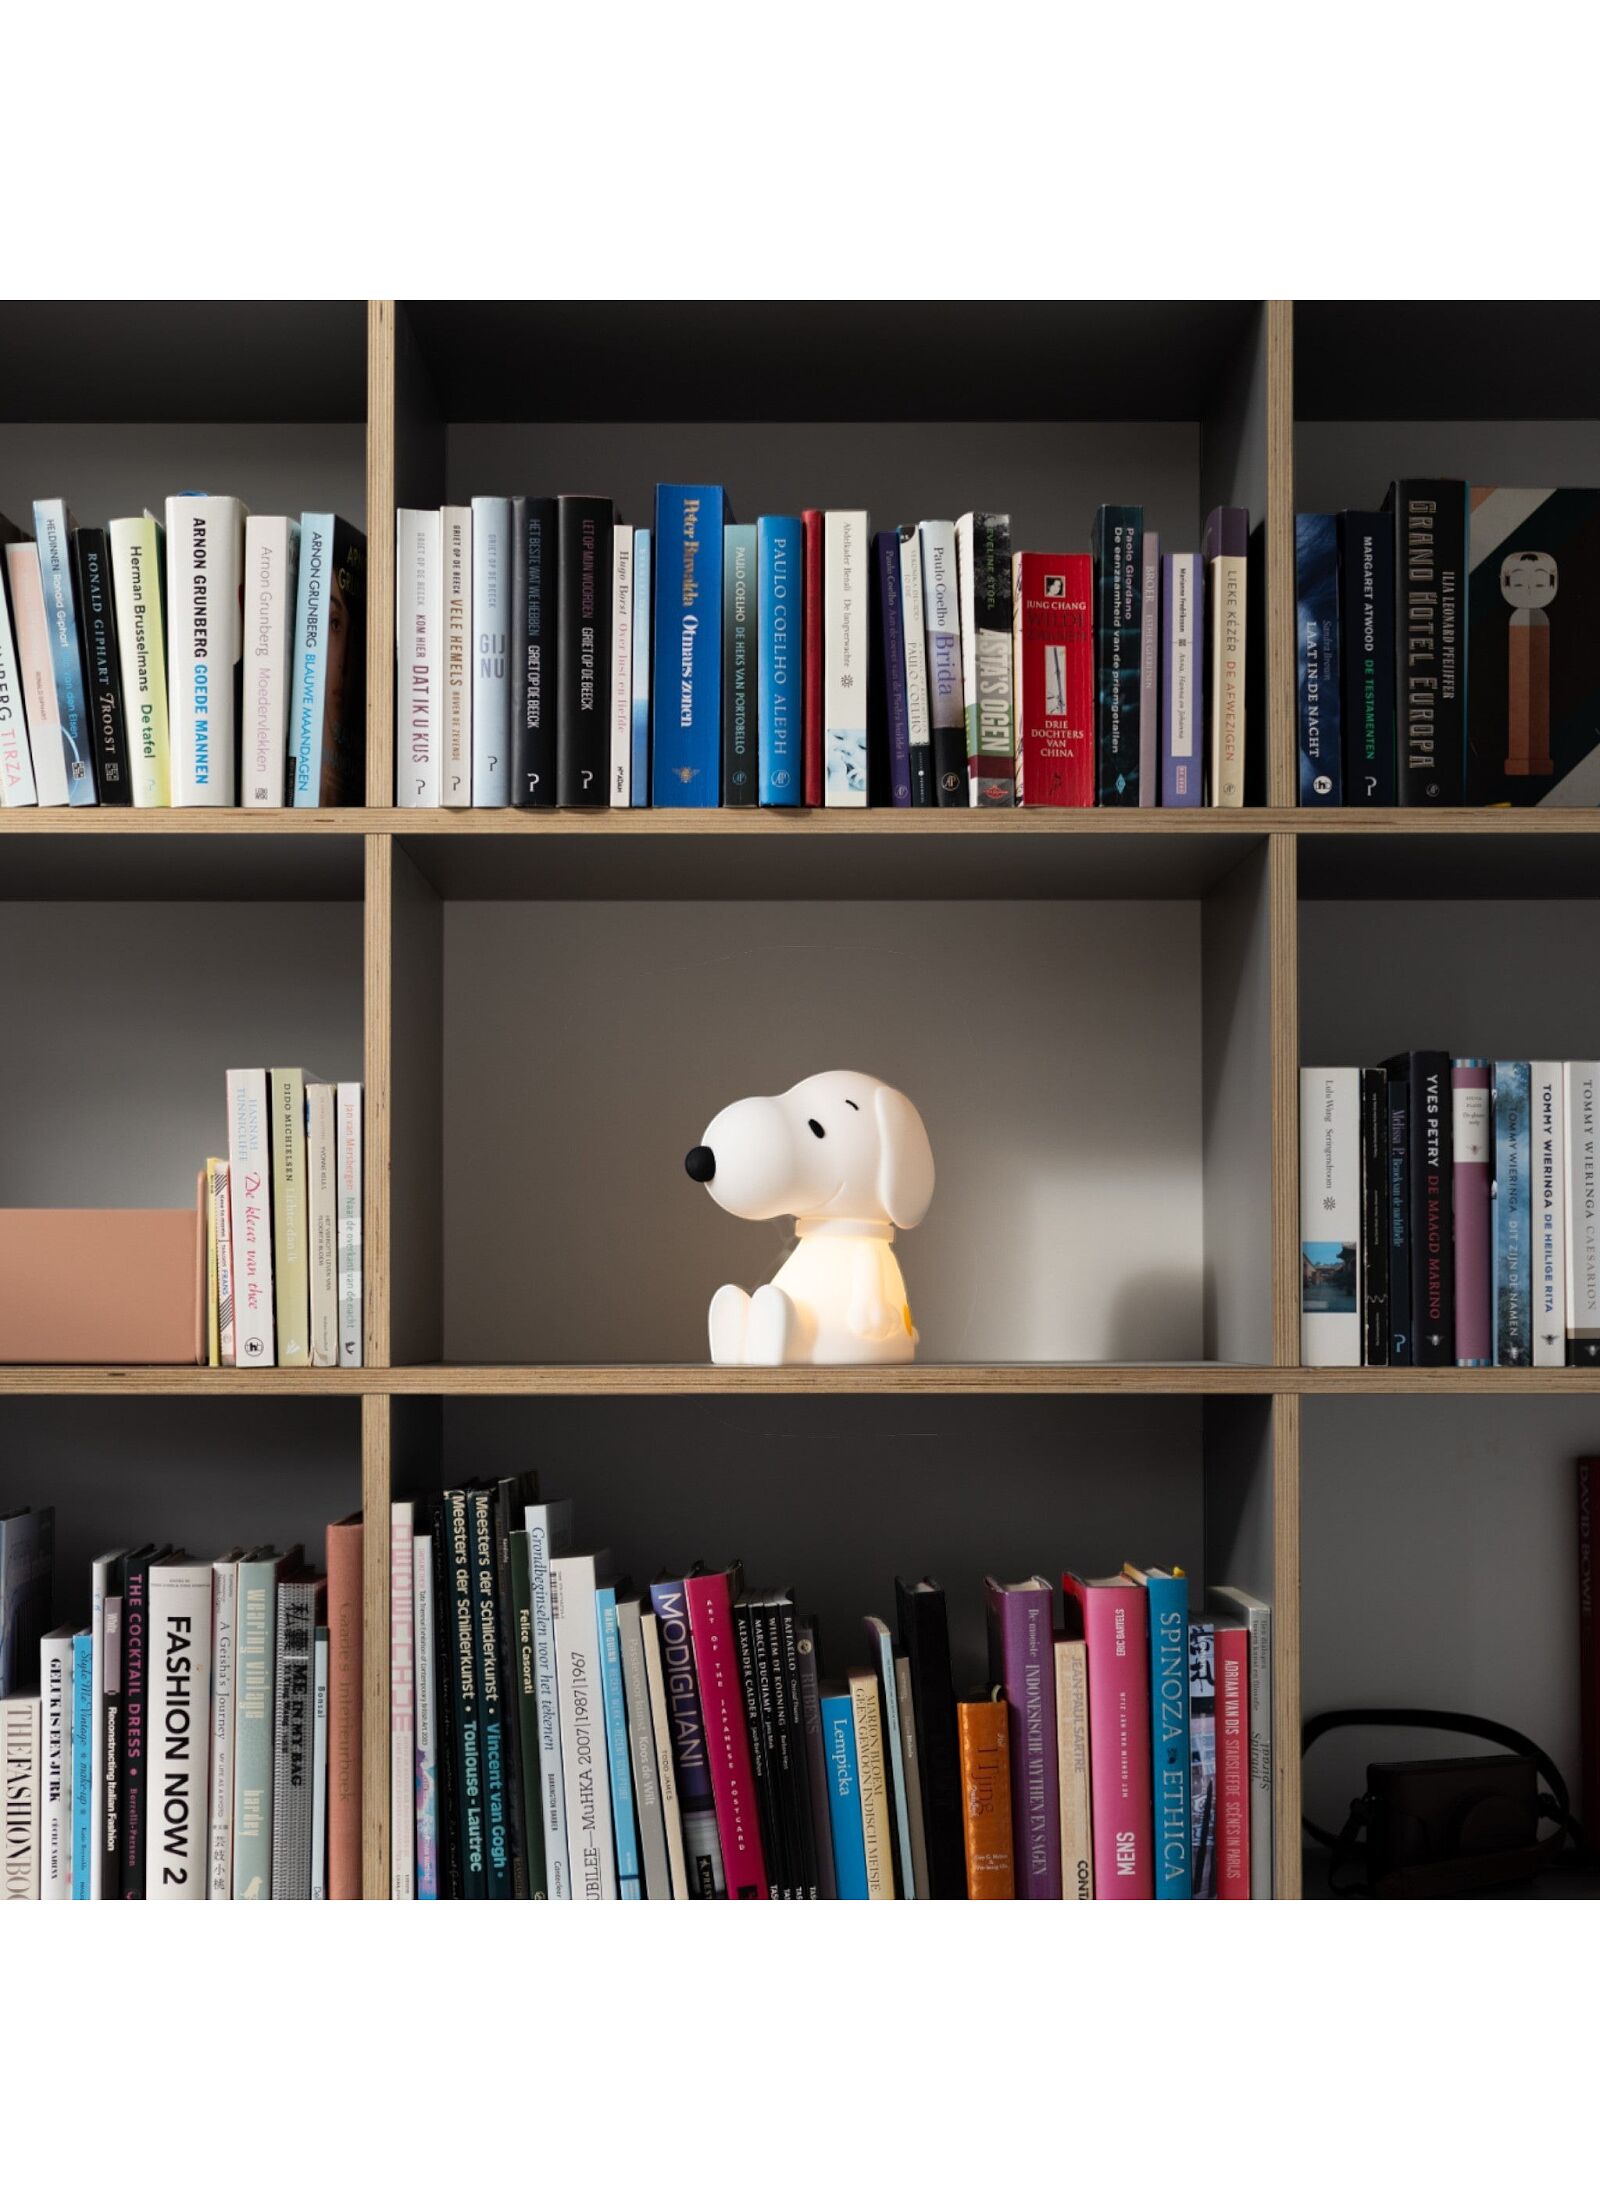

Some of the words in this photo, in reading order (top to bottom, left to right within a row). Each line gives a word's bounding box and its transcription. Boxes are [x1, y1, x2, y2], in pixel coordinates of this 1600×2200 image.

[683, 499, 700, 538] Peter
[1114, 527, 1122, 542] De
[1407, 500, 1437, 581] GRAND
[193, 518, 206, 569] ARNON
[309, 532, 322, 578] ARNON
[618, 551, 629, 580] Hugo
[736, 547, 745, 579] PAULO
[843, 522, 851, 565] Abdelkader
[933, 547, 945, 581] Paulo
[1125, 528, 1134, 561] Paolo
[88, 553, 102, 612] RONALD
[131, 546, 143, 601] Herman
[260, 547, 273, 588] Arnon
[682, 541, 699, 606] Buwalda
[774, 538, 786, 598] PAULO
[843, 568, 851, 591] Benali
[1113, 547, 1122, 626] eenzaamheid
[1227, 571, 1237, 605] LIEKE
[1363, 537, 1374, 599] MARGARET
[1442, 571, 1454, 593] ILJA
[306, 580, 320, 648] GRUNBERG
[619, 585, 629, 615] Borst
[736, 581, 745, 622] COELHO
[843, 599, 851, 609] De
[936, 583, 946, 627] Coelho
[1027, 600, 1049, 609] JUNG
[1052, 601, 1086, 610] CHANG
[1124, 565, 1134, 620] Giordano
[194, 575, 207, 658] GRUNBERG
[256, 592, 272, 656] Grunberg
[618, 623, 627, 651] Over
[736, 627, 745, 639] DE
[1227, 612, 1239, 652] KÉZÉR
[1364, 603, 1374, 651] ATWOOD
[1408, 592, 1438, 666] HOTEL
[1442, 597, 1454, 642] LEONARD
[94, 620, 109, 685] GIPHART
[134, 605, 149, 691] Brusselmans
[480, 634, 506, 654] GIJ
[681, 615, 698, 677] Otmars
[736, 642, 745, 665] HEKS
[774, 605, 786, 684] COELHO
[842, 613, 851, 667] langverwachte
[908, 642, 918, 681] PAULO
[1113, 655, 1121, 668] de
[1306, 621, 1317, 658] LAAT
[302, 654, 315, 704] BLAUWE
[480, 659, 506, 678] NU
[618, 655, 628, 676] lust
[736, 668, 745, 689] VAN
[935, 634, 955, 696] Brida
[1226, 661, 1236, 678] DE
[1307, 663, 1318, 678] IN
[1365, 660, 1374, 674] DE
[1442, 646, 1454, 699] PFEIJFFER
[194, 664, 207, 713] GOEDE
[618, 682, 625, 695] en
[681, 681, 695, 727] zonen
[910, 684, 922, 734] COELHO
[1308, 684, 1318, 701] DE
[100, 693, 116, 754] TROOST
[140, 704, 152, 724] De
[257, 668, 271, 772] Moedervlekken
[617, 700, 627, 733] liefde
[735, 692, 745, 754] PORTOBELLO
[774, 694, 786, 754] ALEPH
[1032, 729, 1084, 739] DOCHTERS
[1046, 721, 1068, 729] DRIE
[1111, 671, 1121, 753] priemgetallen
[1225, 683, 1236, 761] AFWEZIGEN
[1308, 706, 1319, 757] NACHT
[1365, 679, 1375, 759] TESTAMENTEN
[1408, 677, 1438, 769] EUROPA
[2, 729, 21, 786] TIRZA
[142, 728, 155, 758] tafel
[195, 720, 209, 784] MANNEN
[298, 708, 313, 791] MAANDAGEN
[1041, 748, 1073, 757] CHINA
[1324, 1100, 1333, 1122] Wang
[1326, 1080, 1334, 1100] Lulu
[1427, 1075, 1438, 1113] YVES
[1543, 1085, 1552, 1134] TOMMY
[1583, 1080, 1594, 1133] TOMMY
[1427, 1119, 1438, 1167] PETRY
[1509, 1106, 1518, 1149] TOMMY
[1324, 1129, 1334, 1188] Seringendroom
[1544, 1140, 1553, 1208] WIERINGA
[1584, 1142, 1594, 1218] WIERINGA
[244, 1172, 260, 1199] De
[1428, 1175, 1440, 1194] DE
[1509, 1153, 1518, 1213] WIERINGA
[246, 1206, 260, 1242] kleur
[1428, 1200, 1440, 1252] MAAGD
[1509, 1221, 1518, 1240] DIT
[1544, 1214, 1552, 1230] DE
[246, 1251, 256, 1276] van
[1508, 1245, 1518, 1270] ZIJN
[1544, 1234, 1553, 1281] HEILIGE
[1585, 1226, 1596, 1310] CAESARION
[221, 1269, 229, 1295] FRANS
[247, 1283, 261, 1309] thee
[1429, 1259, 1440, 1319] MARINO
[1509, 1274, 1518, 1288] DE
[1545, 1285, 1554, 1312] RITA
[1510, 1292, 1518, 1336] NAMEN
[1580, 1466, 1590, 1536] DAVID
[475, 1497, 491, 1565] Meesters
[479, 1570, 493, 1595] der
[531, 1527, 549, 1636] Grondbeginselen
[1582, 1544, 1592, 1616] BOWIE
[219, 1621, 230, 1630] A
[520, 1609, 531, 1642] Felice
[754, 1620, 765, 1658] MARCEL
[784, 1617, 796, 1671] RAFFAELLO
[1115, 1609, 1124, 1639] BARTELS
[480, 1601, 498, 1702] Schilderkunst
[522, 1646, 534, 1693] Casorati
[537, 1642, 552, 1670] voor
[738, 1619, 751, 1677] ALEXANDER
[745, 1679, 757, 1718] CALDER
[1116, 1641, 1125, 1656] ERIC
[50, 1659, 61, 1707] GELUK
[165, 1616, 191, 1760] FASHION
[293, 1665, 307, 1696] ME
[540, 1675, 553, 1695] het
[658, 1592, 703, 1767] MODIGLIANI
[759, 1662, 772, 1712] DUCHAMP
[1160, 1613, 1183, 1740] SPINOZA
[50, 1712, 61, 1726] IS
[216, 1692, 229, 1740] Journey
[292, 1701, 303, 1718] IN
[541, 1700, 556, 1750] tekenen
[50, 1730, 61, 1758] EEN
[106, 1707, 117, 1780] Reconstructing
[292, 1723, 303, 1749] MY
[486, 1722, 503, 1790] Vincent
[830, 1720, 852, 1796] Lempicka
[49, 1761, 61, 1802] JURK
[291, 1752, 303, 1786] BAG
[107, 1782, 117, 1810] Italian
[163, 1773, 189, 1857] NOW
[490, 1792, 502, 1822] van
[107, 1813, 117, 1851] Fashion
[487, 1824, 505, 1868] Gogh
[1164, 1770, 1185, 1881] ETHICA
[1116, 1832, 1135, 1875] MENS
[163, 1867, 188, 1885] 2
